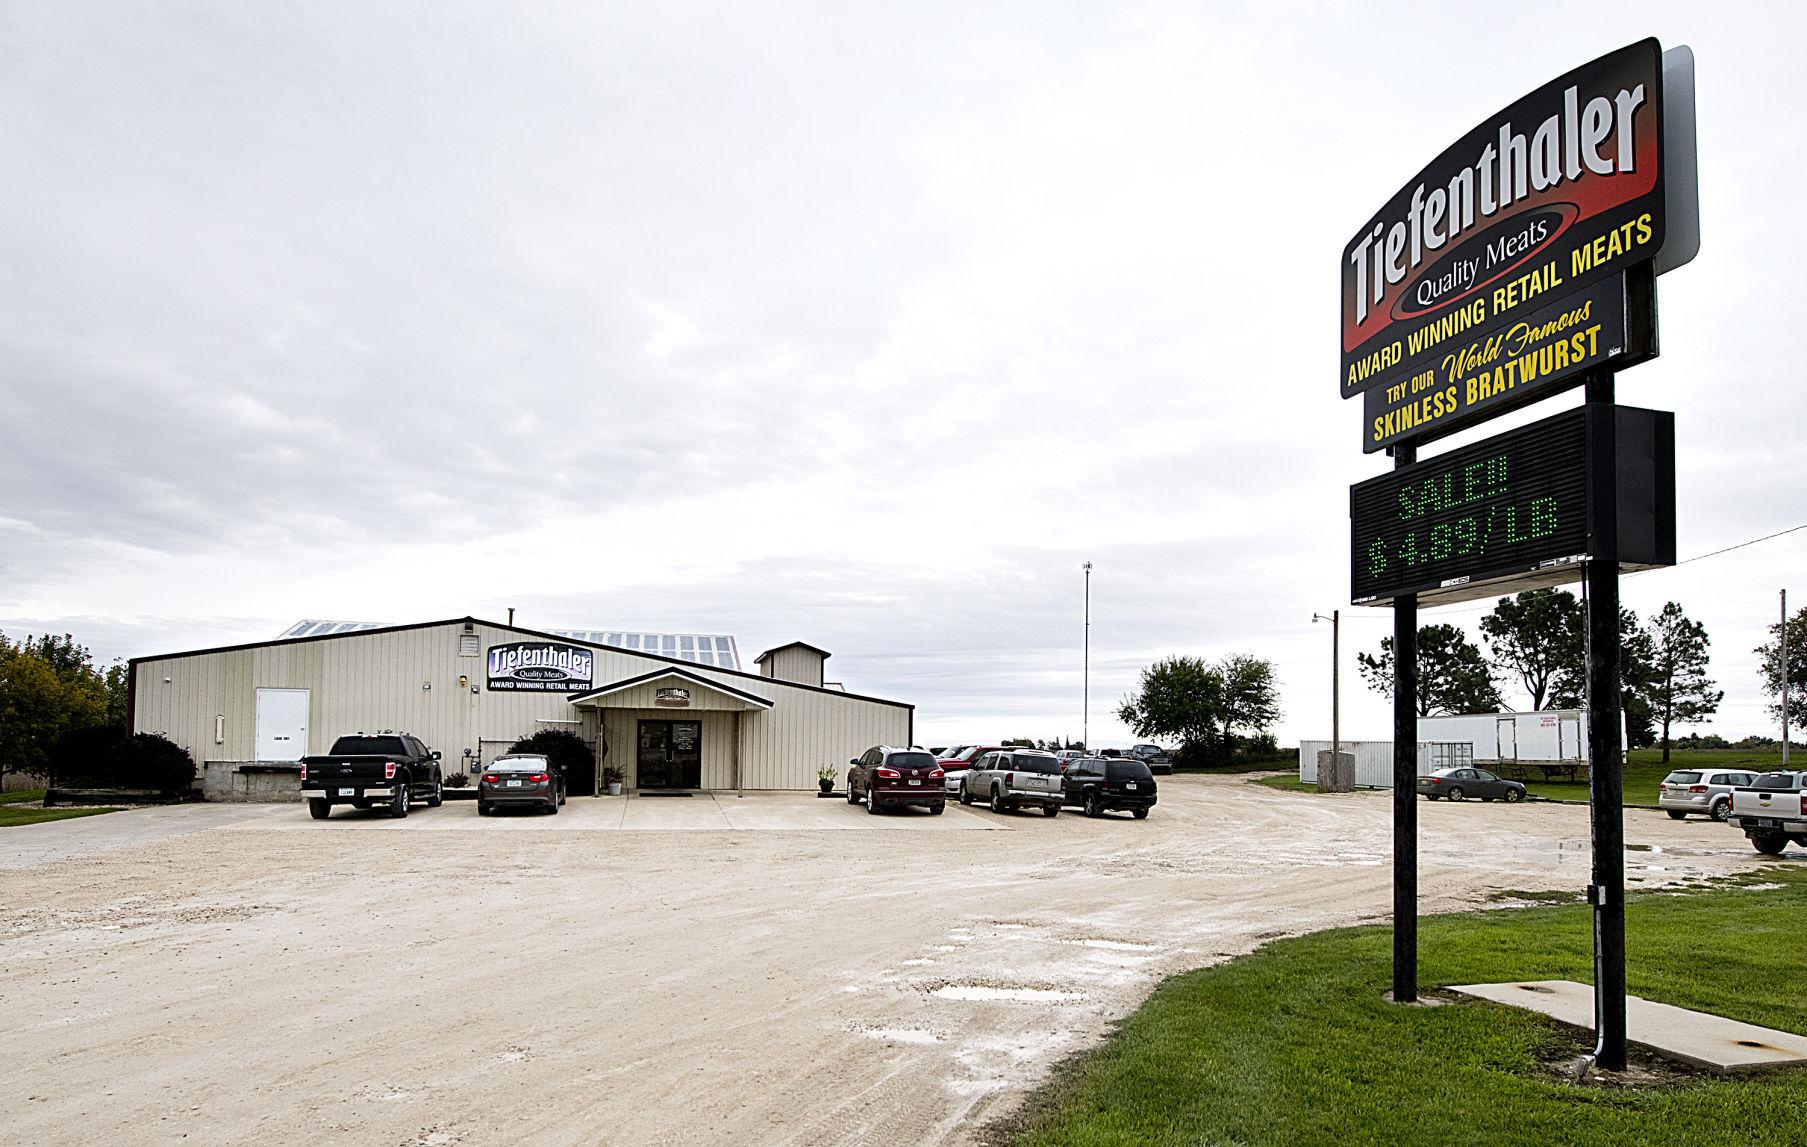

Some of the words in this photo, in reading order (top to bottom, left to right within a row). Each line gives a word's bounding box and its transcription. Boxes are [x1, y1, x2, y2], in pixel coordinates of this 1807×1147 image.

[1351, 83, 1645, 326] Tiefenthaler
[1347, 341, 1402, 386] AWARD
[1408, 298, 1485, 356] WINNING
[1493, 263, 1563, 316] RETAIL
[1572, 213, 1652, 278] MEATS
[1417, 255, 1480, 306] Quality
[1485, 218, 1548, 270] Meats
[1374, 385, 1458, 442] SKINLESS
[1466, 323, 1601, 406] BRATWURST
[1386, 381, 1407, 405] TRY
[1411, 369, 1434, 395] OUR
[1441, 336, 1503, 383] World
[1506, 300, 1593, 357] Famous
[1398, 455, 1508, 521] SALE!!
[492, 645, 592, 675] Tiefenthaler
[516, 681, 545, 689] WINNING
[519, 670, 542, 678] Quality
[544, 670, 564, 678] Meats
